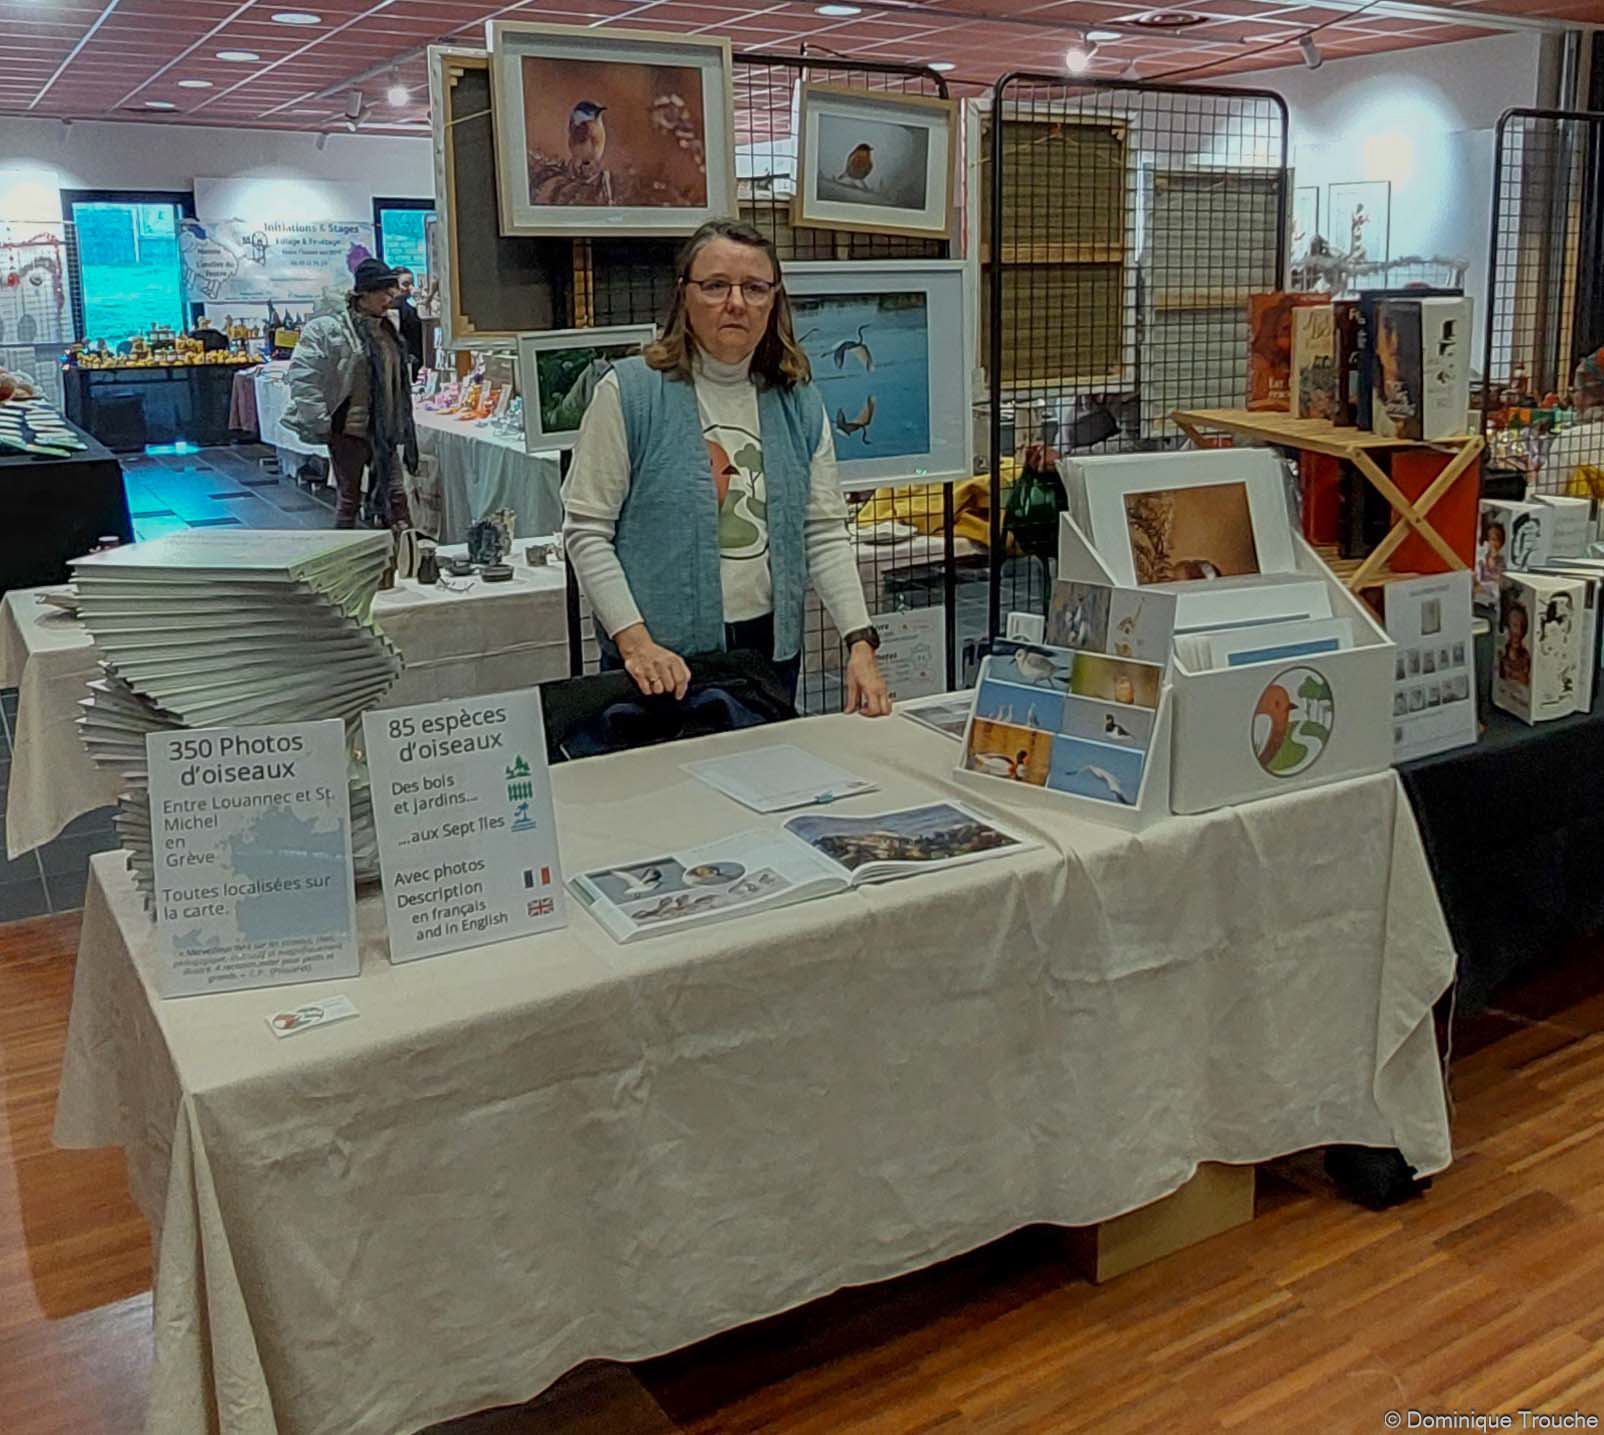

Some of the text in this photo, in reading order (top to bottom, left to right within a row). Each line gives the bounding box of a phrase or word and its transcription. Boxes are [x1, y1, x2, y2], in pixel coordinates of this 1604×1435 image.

[328, 224, 360, 235] Stages
[389, 707, 507, 739] 85 espèces
[168, 734, 303, 761] 350 Photos
[399, 732, 504, 762] d'oiseaux
[181, 761, 296, 786] d'oiseaux
[391, 774, 455, 796] Des bois
[163, 798, 207, 814] Entre
[211, 791, 290, 811] Louannec
[295, 789, 311, 802] et
[393, 802, 410, 815] et
[164, 815, 218, 832] Michel
[442, 819, 475, 838] Sept
[165, 837, 186, 850] en
[166, 850, 216, 868] Grève
[394, 858, 486, 887] Avec photos
[163, 875, 331, 903] Toutes localisées sur
[397, 881, 483, 909] Description
[164, 906, 178, 920] la
[412, 899, 487, 924] en français
[416, 911, 509, 941] and in English
